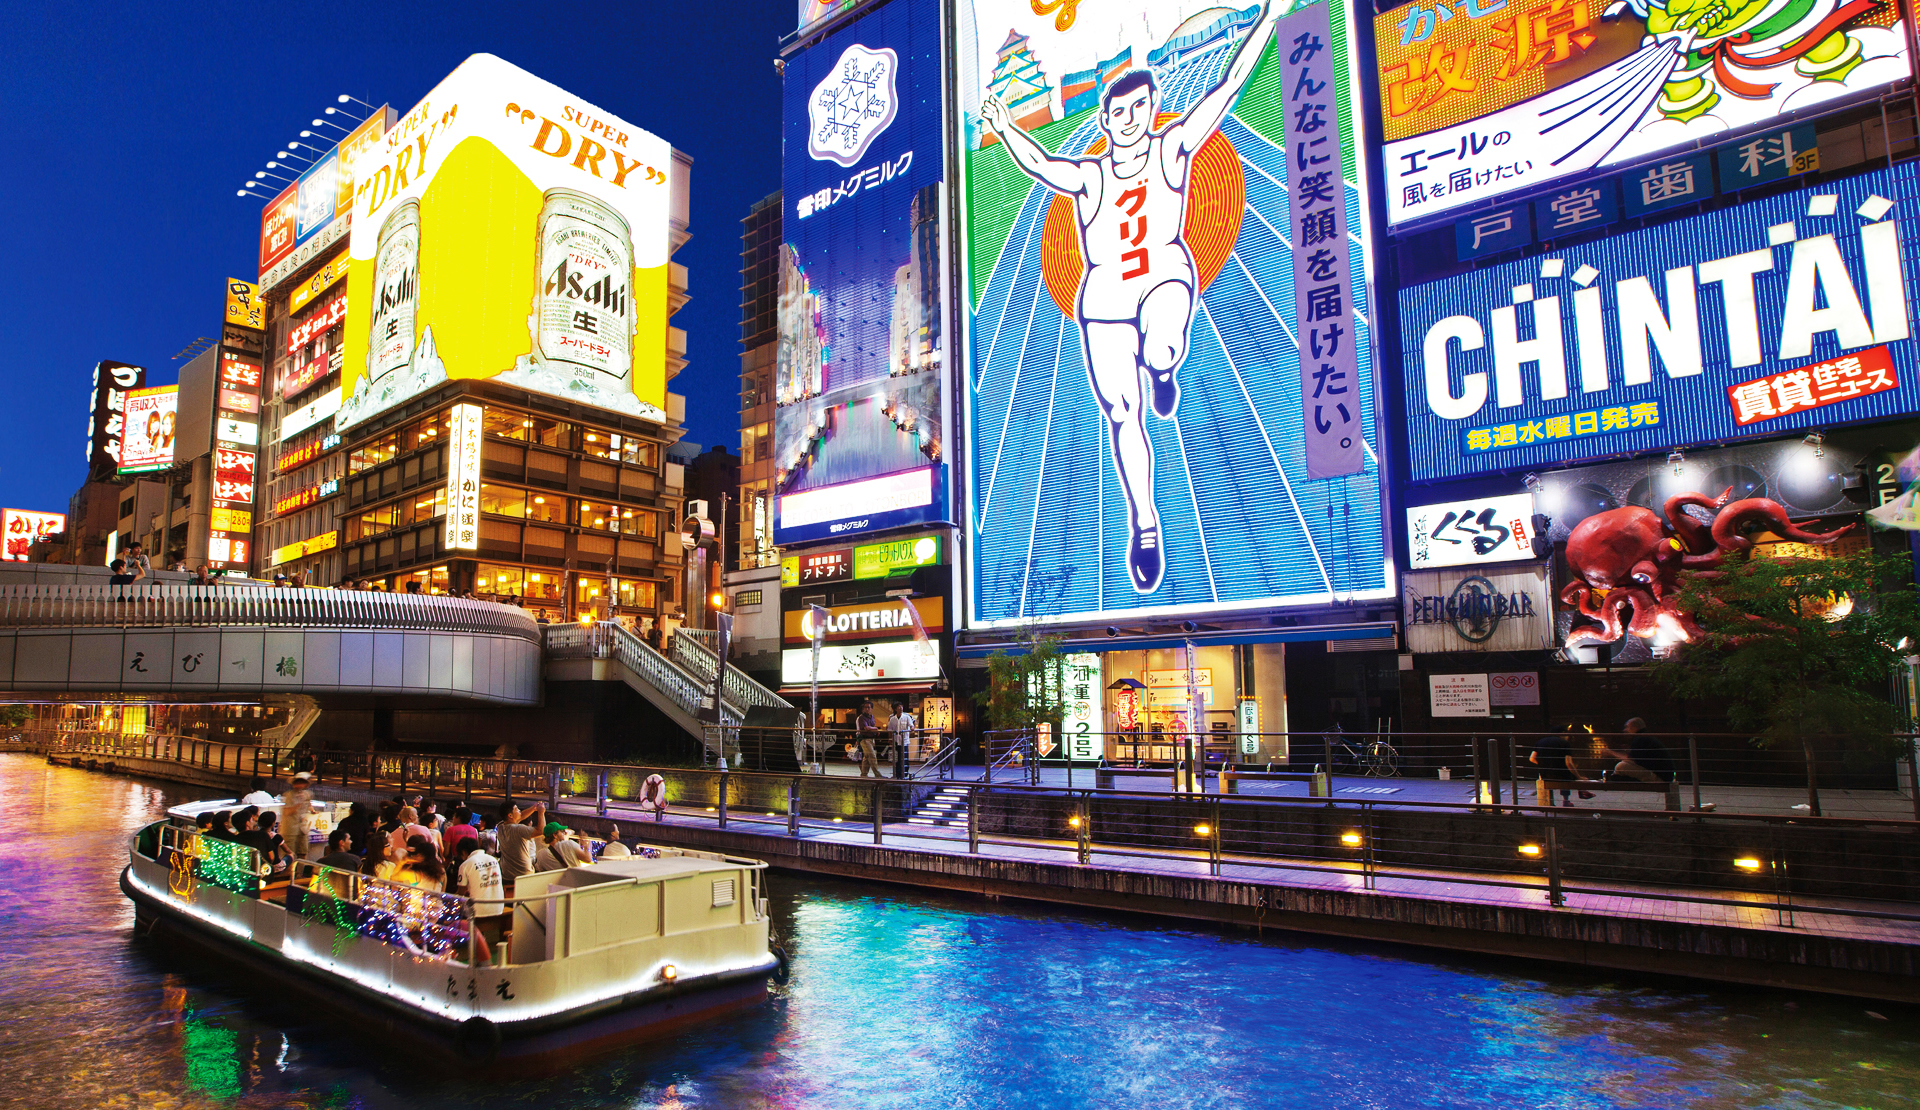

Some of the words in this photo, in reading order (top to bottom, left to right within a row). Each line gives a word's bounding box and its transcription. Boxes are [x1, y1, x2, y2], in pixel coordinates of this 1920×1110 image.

[561, 104, 629, 149] SUPER
[1400, 131, 1512, 177] エールの
[1795, 153, 1817, 172] 3F
[797, 151, 914, 220] 雪印メグミルク
[1402, 160, 1533, 209] 風を届けたい
[1471, 131, 1799, 251] 戸堂歯科
[1115, 178, 1150, 281] グリコ
[1287, 30, 1352, 450] みんなに笑顔を届けたい。
[374, 267, 415, 326] Asahi
[545, 258, 625, 318] Asahi
[385, 318, 399, 341] 生
[572, 310, 598, 335] 生
[224, 352, 239, 361] 8F
[560, 336, 612, 358] スーパードライ
[1813, 356, 1862, 385] 住宅
[1818, 368, 1893, 401] ニュース
[222, 381, 236, 390] 7F
[1732, 370, 1817, 423] 賃貸
[129, 398, 159, 413] 高収入
[220, 411, 235, 419] 6F
[1466, 401, 1661, 452] 毎週水曜日発売
[217, 451, 255, 472] はや
[213, 500, 229, 508] 3F
[215, 480, 252, 501] はや
[460, 478, 476, 544] かに道楽
[211, 531, 226, 540] 2F
[1431, 507, 1510, 556] くくる
[210, 561, 224, 569] 1F
[804, 563, 848, 580] アドアド
[1495, 590, 1537, 618] BAR
[827, 608, 913, 633] LOTTERIA
[129, 651, 298, 678] えびす橋
[1073, 665, 1091, 699] 河童
[1074, 722, 1093, 756] 2号
